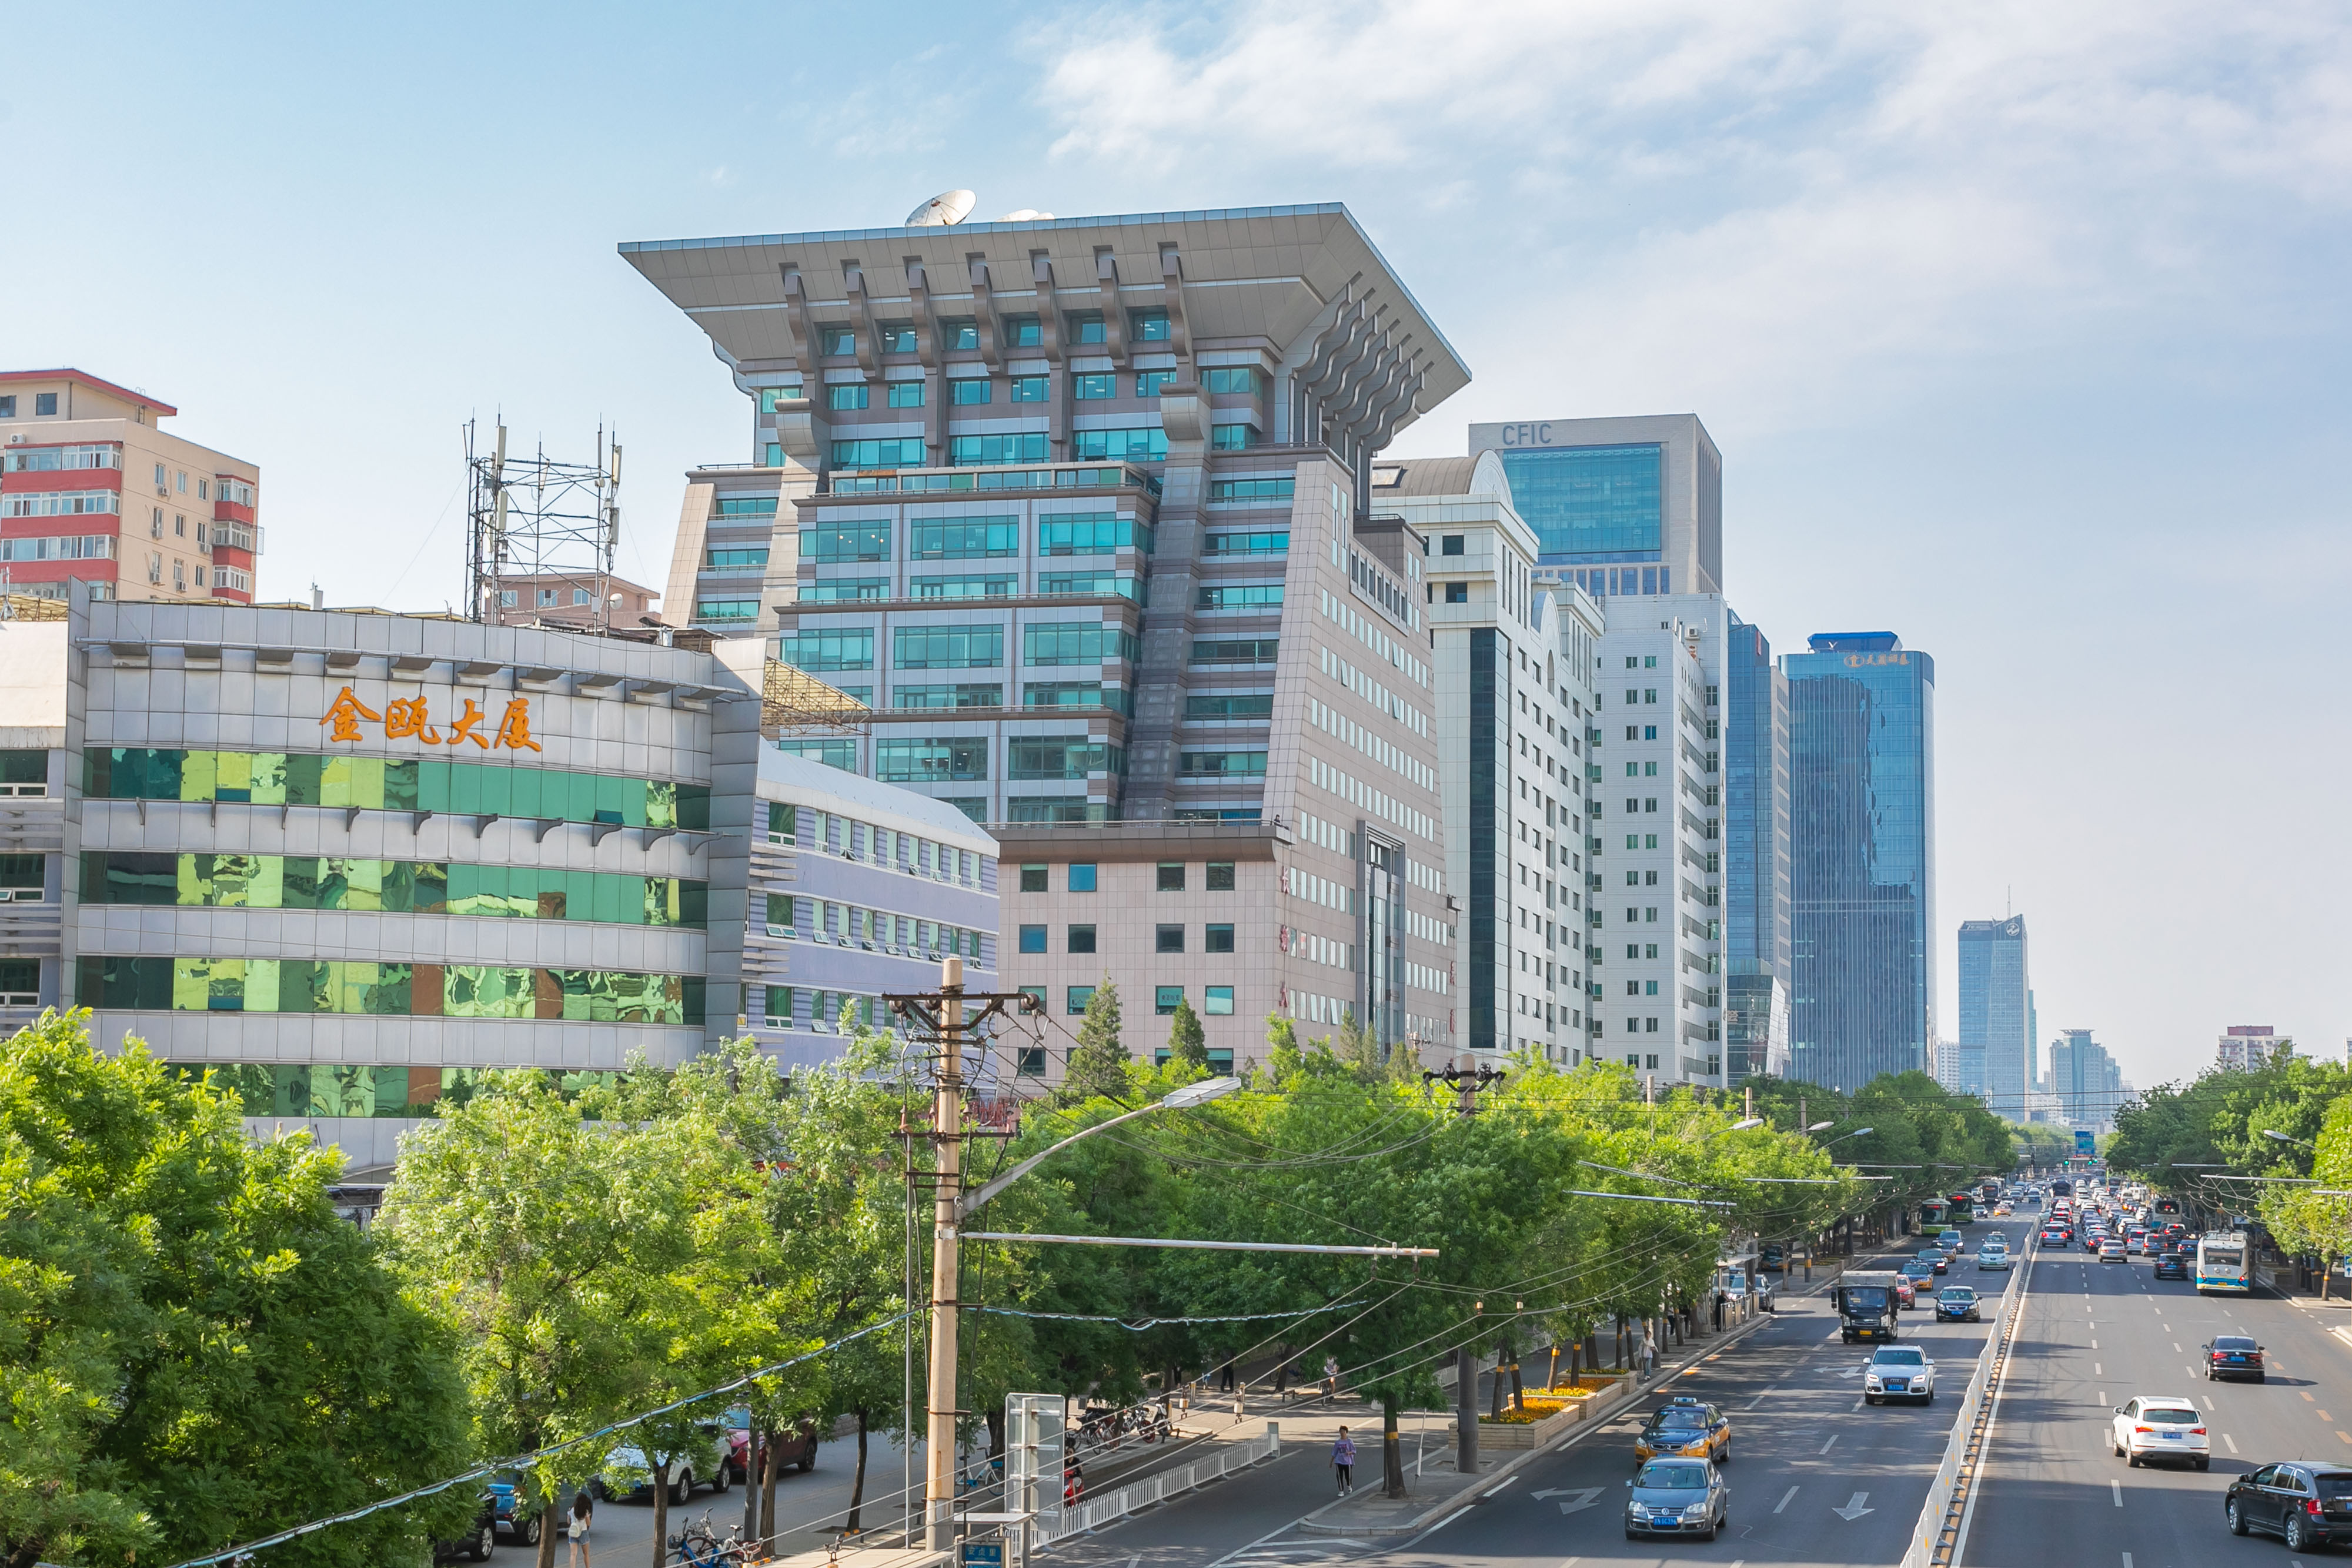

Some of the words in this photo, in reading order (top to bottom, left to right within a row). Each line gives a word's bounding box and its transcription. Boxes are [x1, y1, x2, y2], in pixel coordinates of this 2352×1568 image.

[1502, 423, 1552, 446] CFIC
[319, 686, 542, 752] 金瓯大厦
